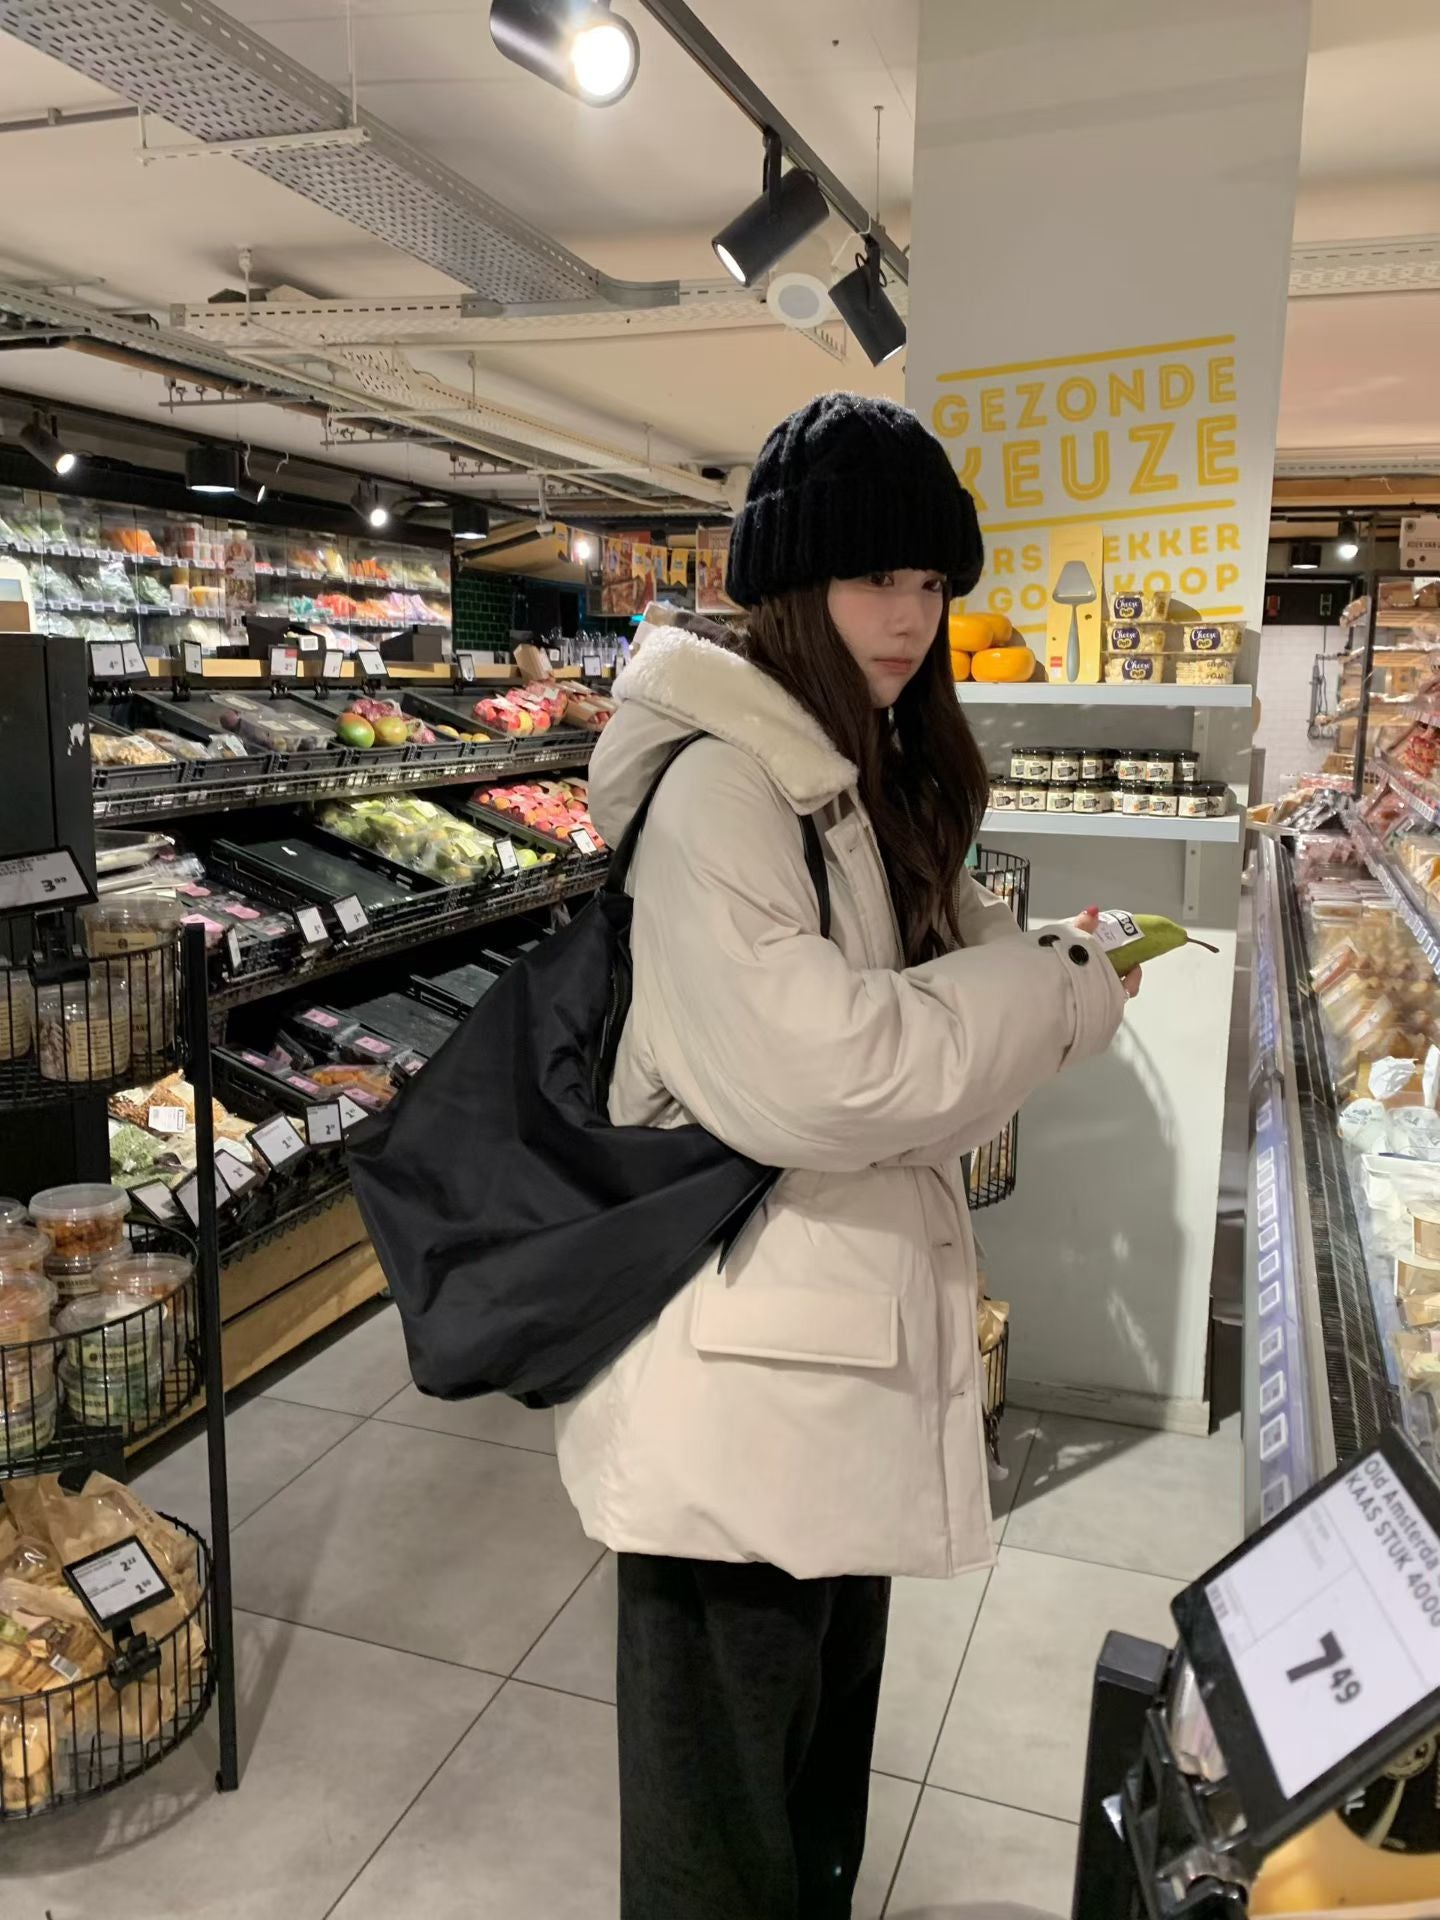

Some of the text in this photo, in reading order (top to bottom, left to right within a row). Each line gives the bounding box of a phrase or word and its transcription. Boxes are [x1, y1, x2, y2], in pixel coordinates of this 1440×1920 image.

[931, 355, 1237, 438] GEZONDE
[1345, 1470, 1383, 1523] KAAS
[1374, 1520, 1414, 1572] STUK
[1364, 1459, 1440, 1580] Old Amsterda
